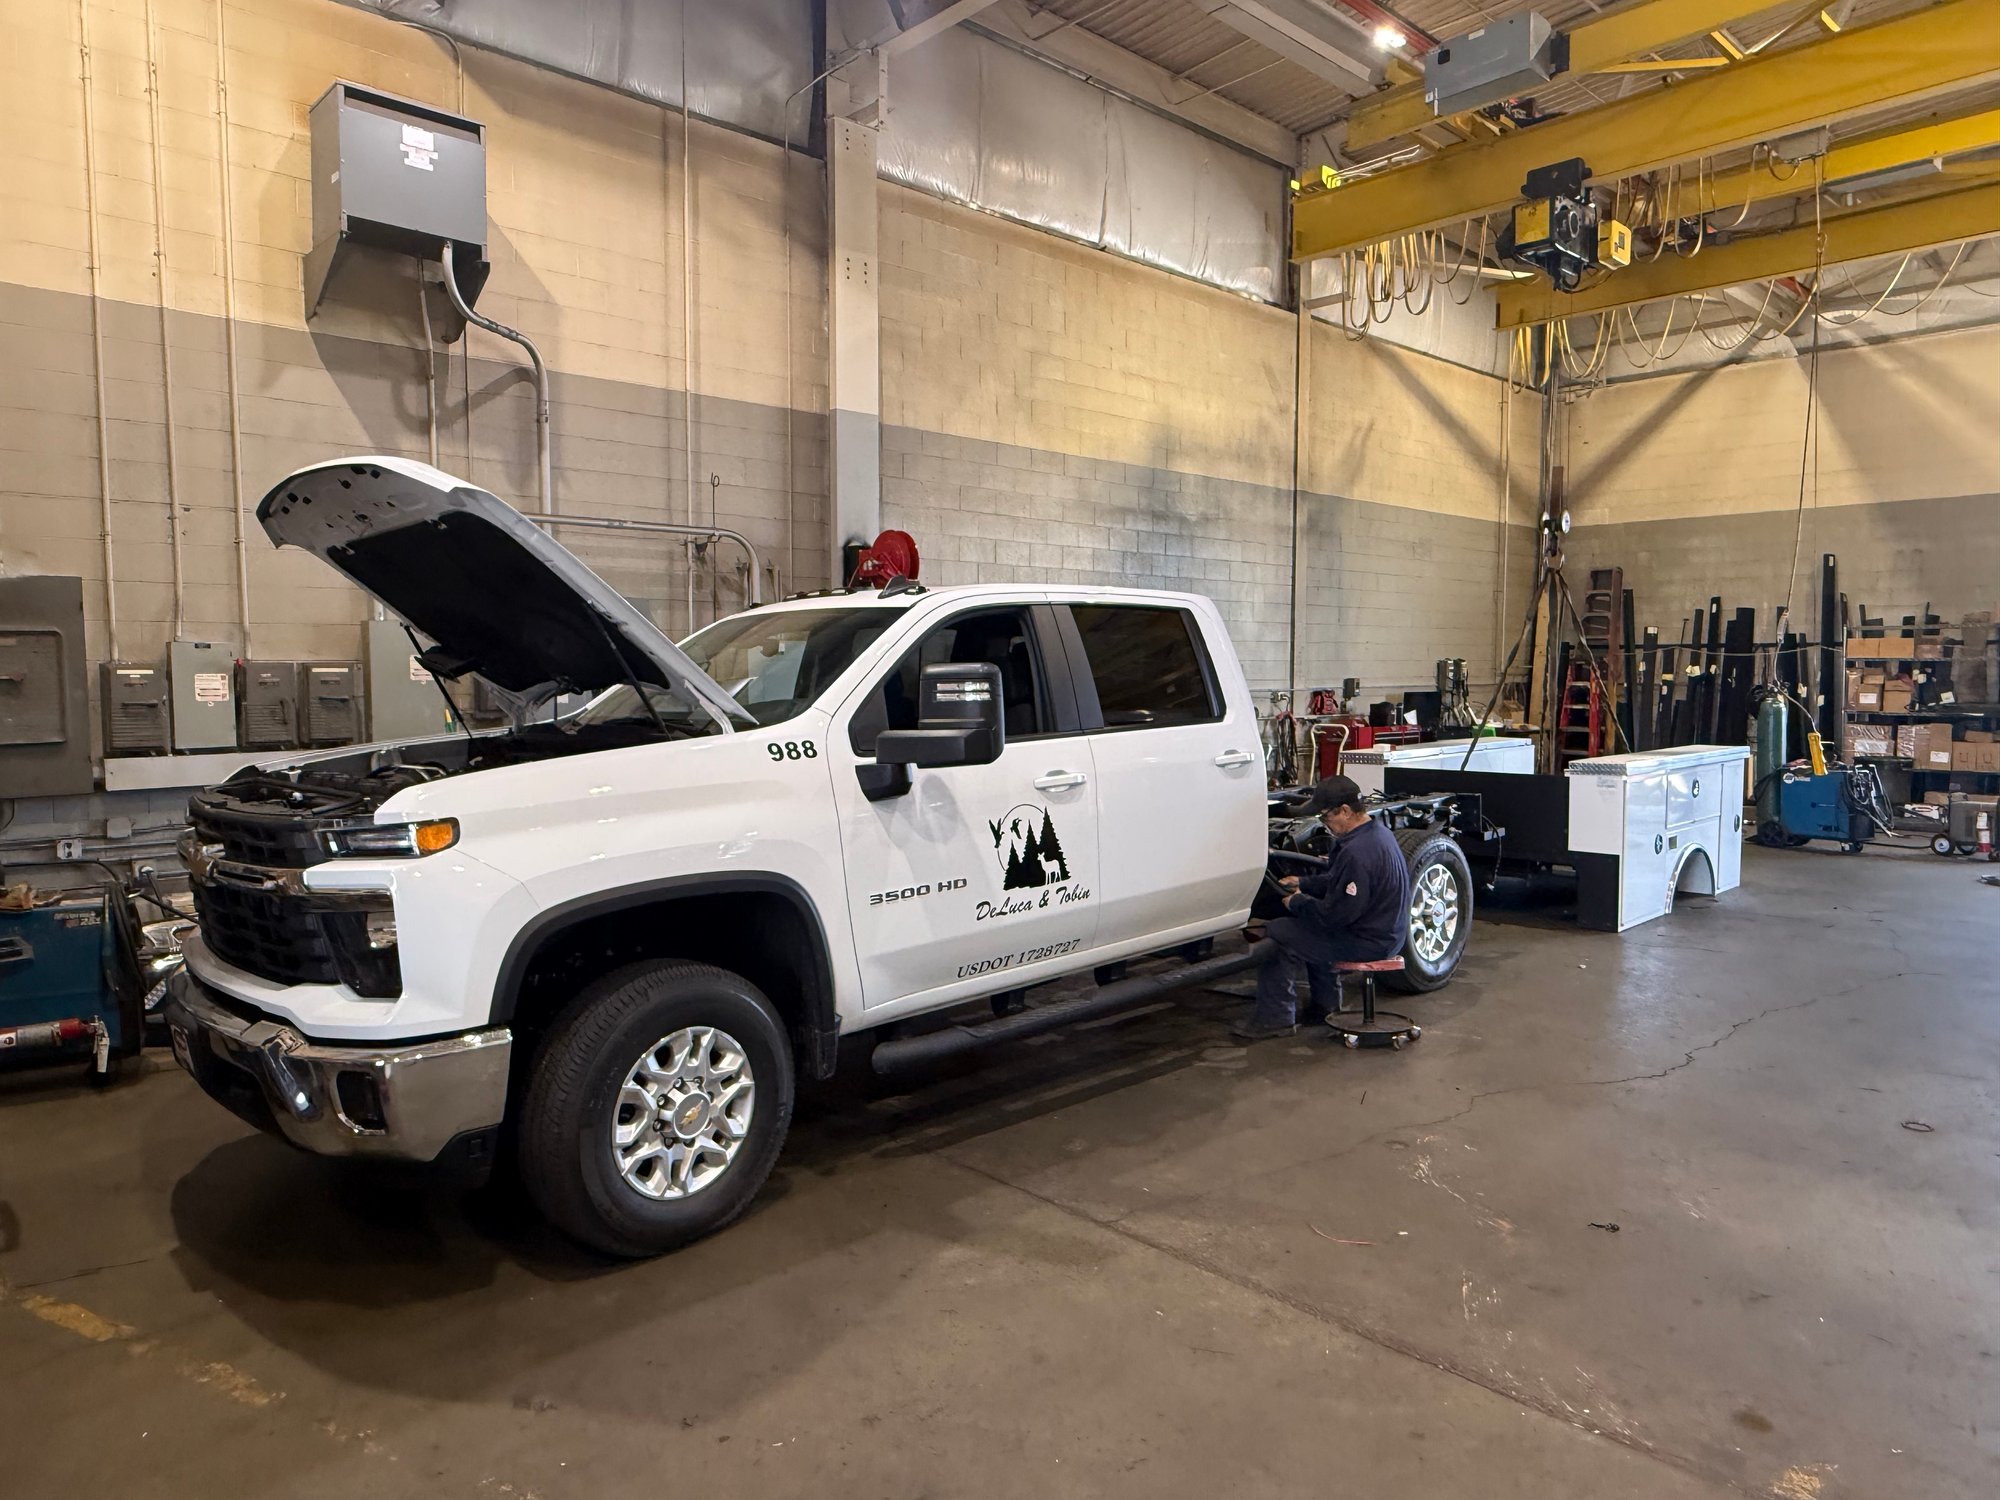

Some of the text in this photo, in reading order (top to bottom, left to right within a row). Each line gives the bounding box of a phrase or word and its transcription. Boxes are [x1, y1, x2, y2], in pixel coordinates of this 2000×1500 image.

[767, 740, 818, 762] 988
[869, 878, 968, 906] 3500 HD
[976, 883, 1091, 921] DeLuca & Tobin
[957, 938, 1081, 979] USDOT 1728727
